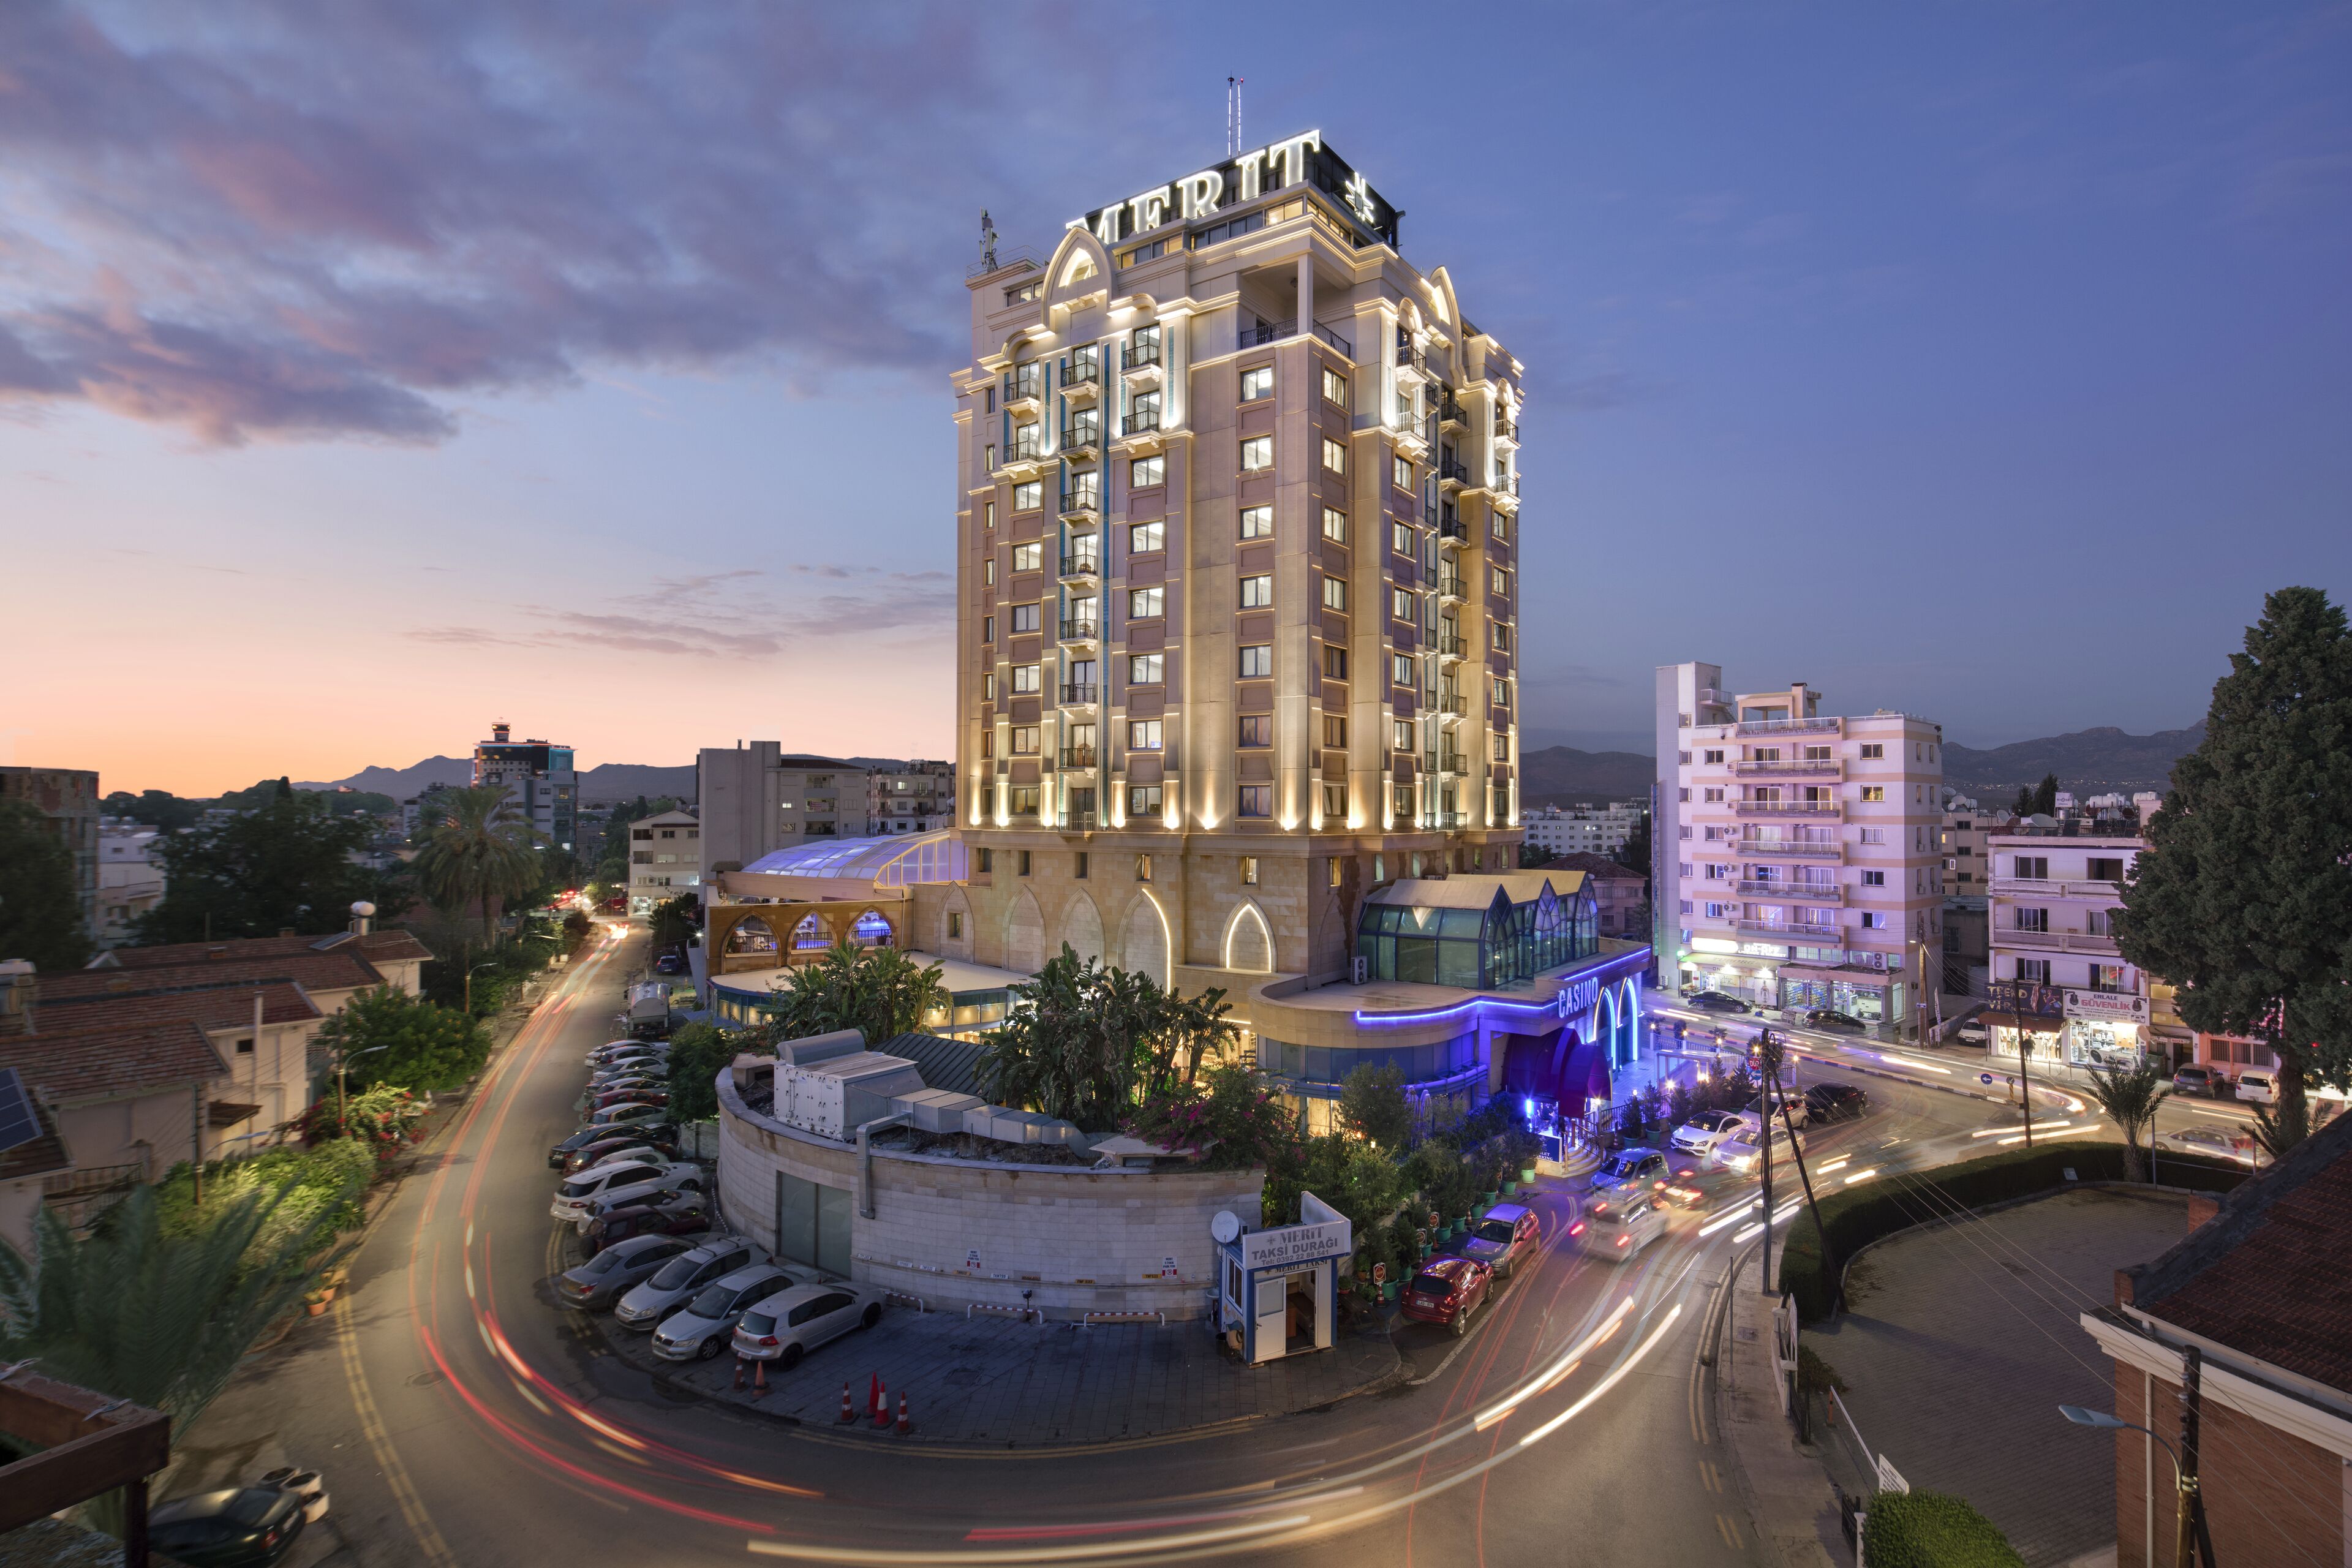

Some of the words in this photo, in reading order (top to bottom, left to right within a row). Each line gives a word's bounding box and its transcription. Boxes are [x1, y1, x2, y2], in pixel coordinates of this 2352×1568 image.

[1559, 977, 1598, 1018] CASINO
[2081, 998, 2131, 1011] GÜVENLİK
[1252, 1243, 1288, 1261] TAKSİ
[1292, 1237, 1338, 1254] DURAĞI
